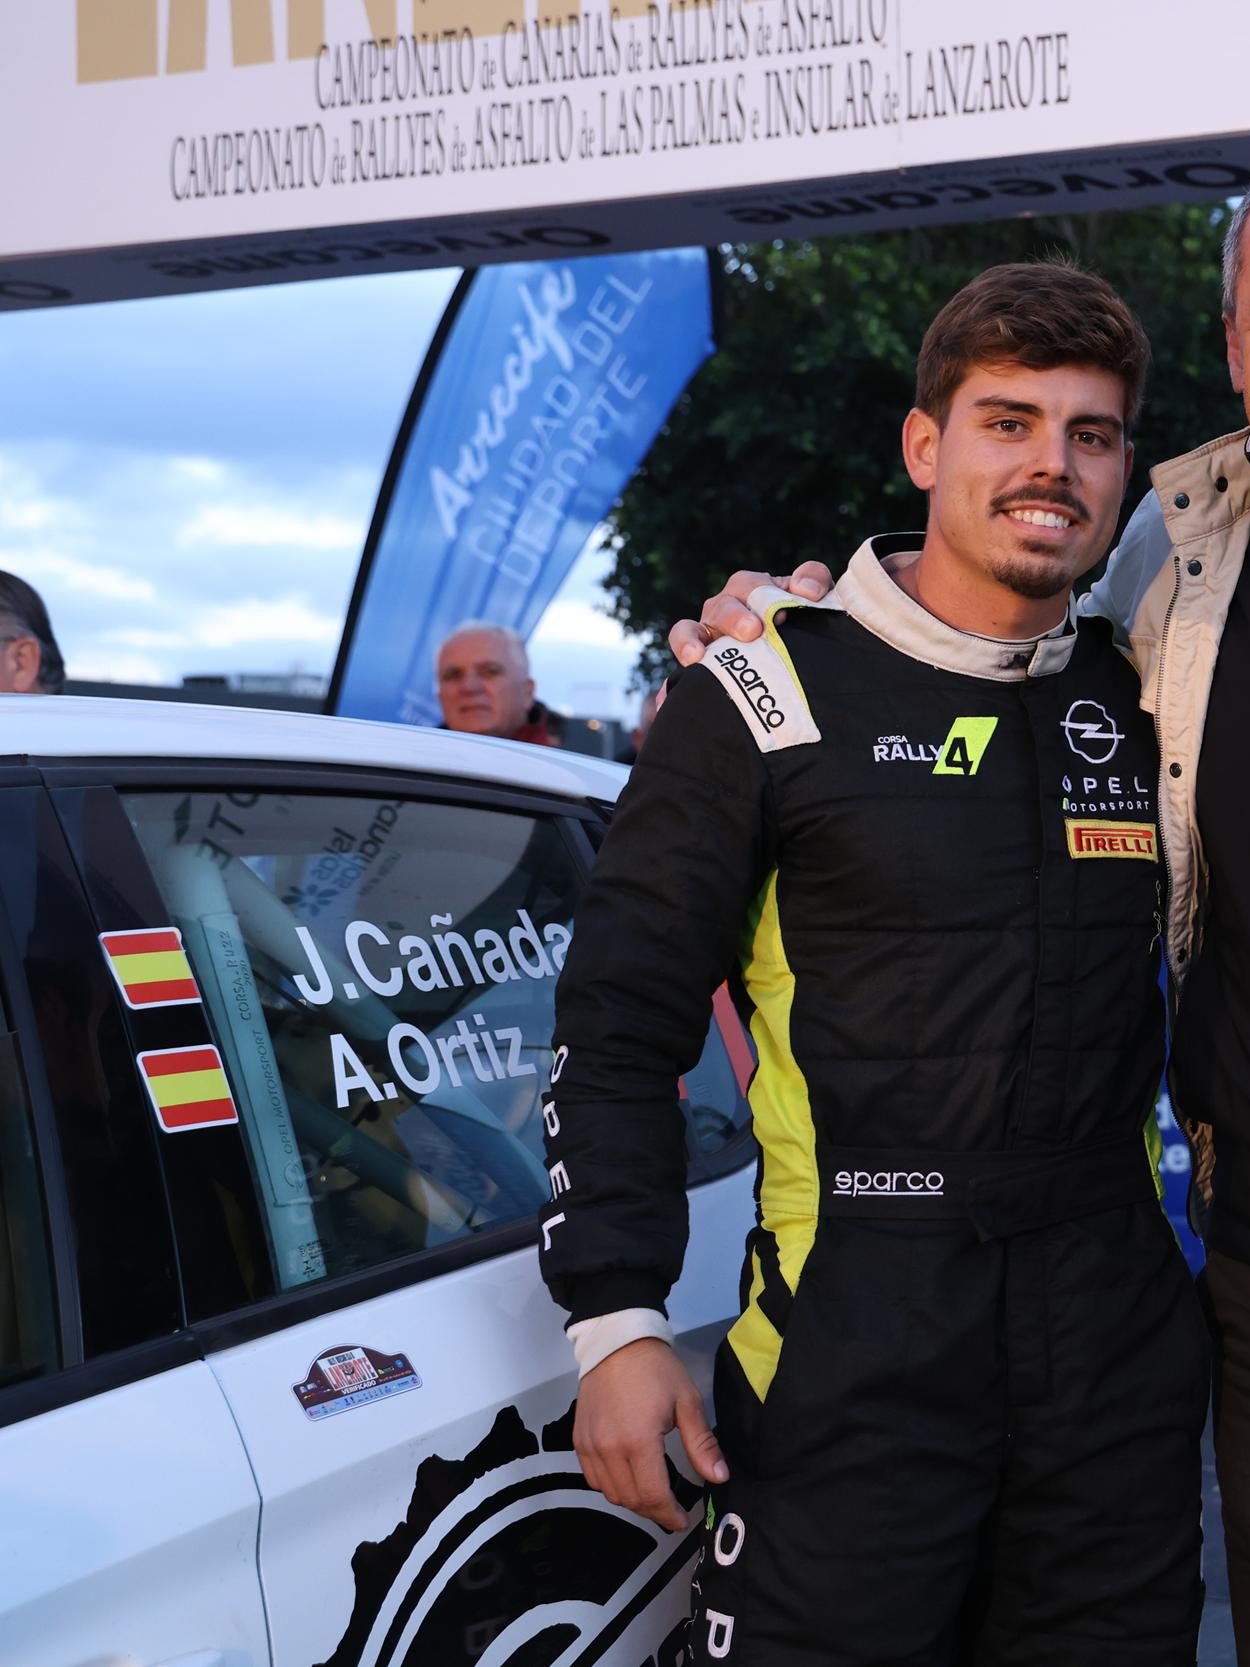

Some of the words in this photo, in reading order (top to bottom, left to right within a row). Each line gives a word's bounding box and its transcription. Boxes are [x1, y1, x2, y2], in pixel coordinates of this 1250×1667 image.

[315, 26, 474, 110] CAMPEONATO
[481, 42, 496, 90] de
[501, 8, 621, 88] CANARIAS
[627, 24, 643, 72] de
[648, 0, 749, 70] RALLYES
[756, 6, 772, 56] de
[170, 122, 326, 201] CAMPEONATO
[331, 137, 346, 185] de
[352, 109, 446, 183] RALLYES
[451, 125, 465, 172] de
[471, 95, 573, 171] ASFALTO
[578, 110, 594, 158] de
[600, 86, 644, 157] LAS
[650, 73, 746, 151] PALMAS
[752, 108, 759, 140] e
[765, 58, 877, 139] INSULAR
[881, 73, 899, 124] de
[905, 32, 1070, 121] LANZAROTE
[570, 273, 653, 367] DEL
[500, 352, 649, 588] DEPORTE
[715, 646, 785, 734] sparco
[877, 734, 909, 744] CORSA
[1062, 775, 1148, 794] OPEL
[1073, 827, 1153, 854] PIRELLI
[253, 1030, 285, 1118] MOTORSPORT
[329, 1013, 538, 1109] A.Ortiz
[834, 1168, 945, 1197] sparco
[341, 1380, 377, 1395] VERIFICADO
